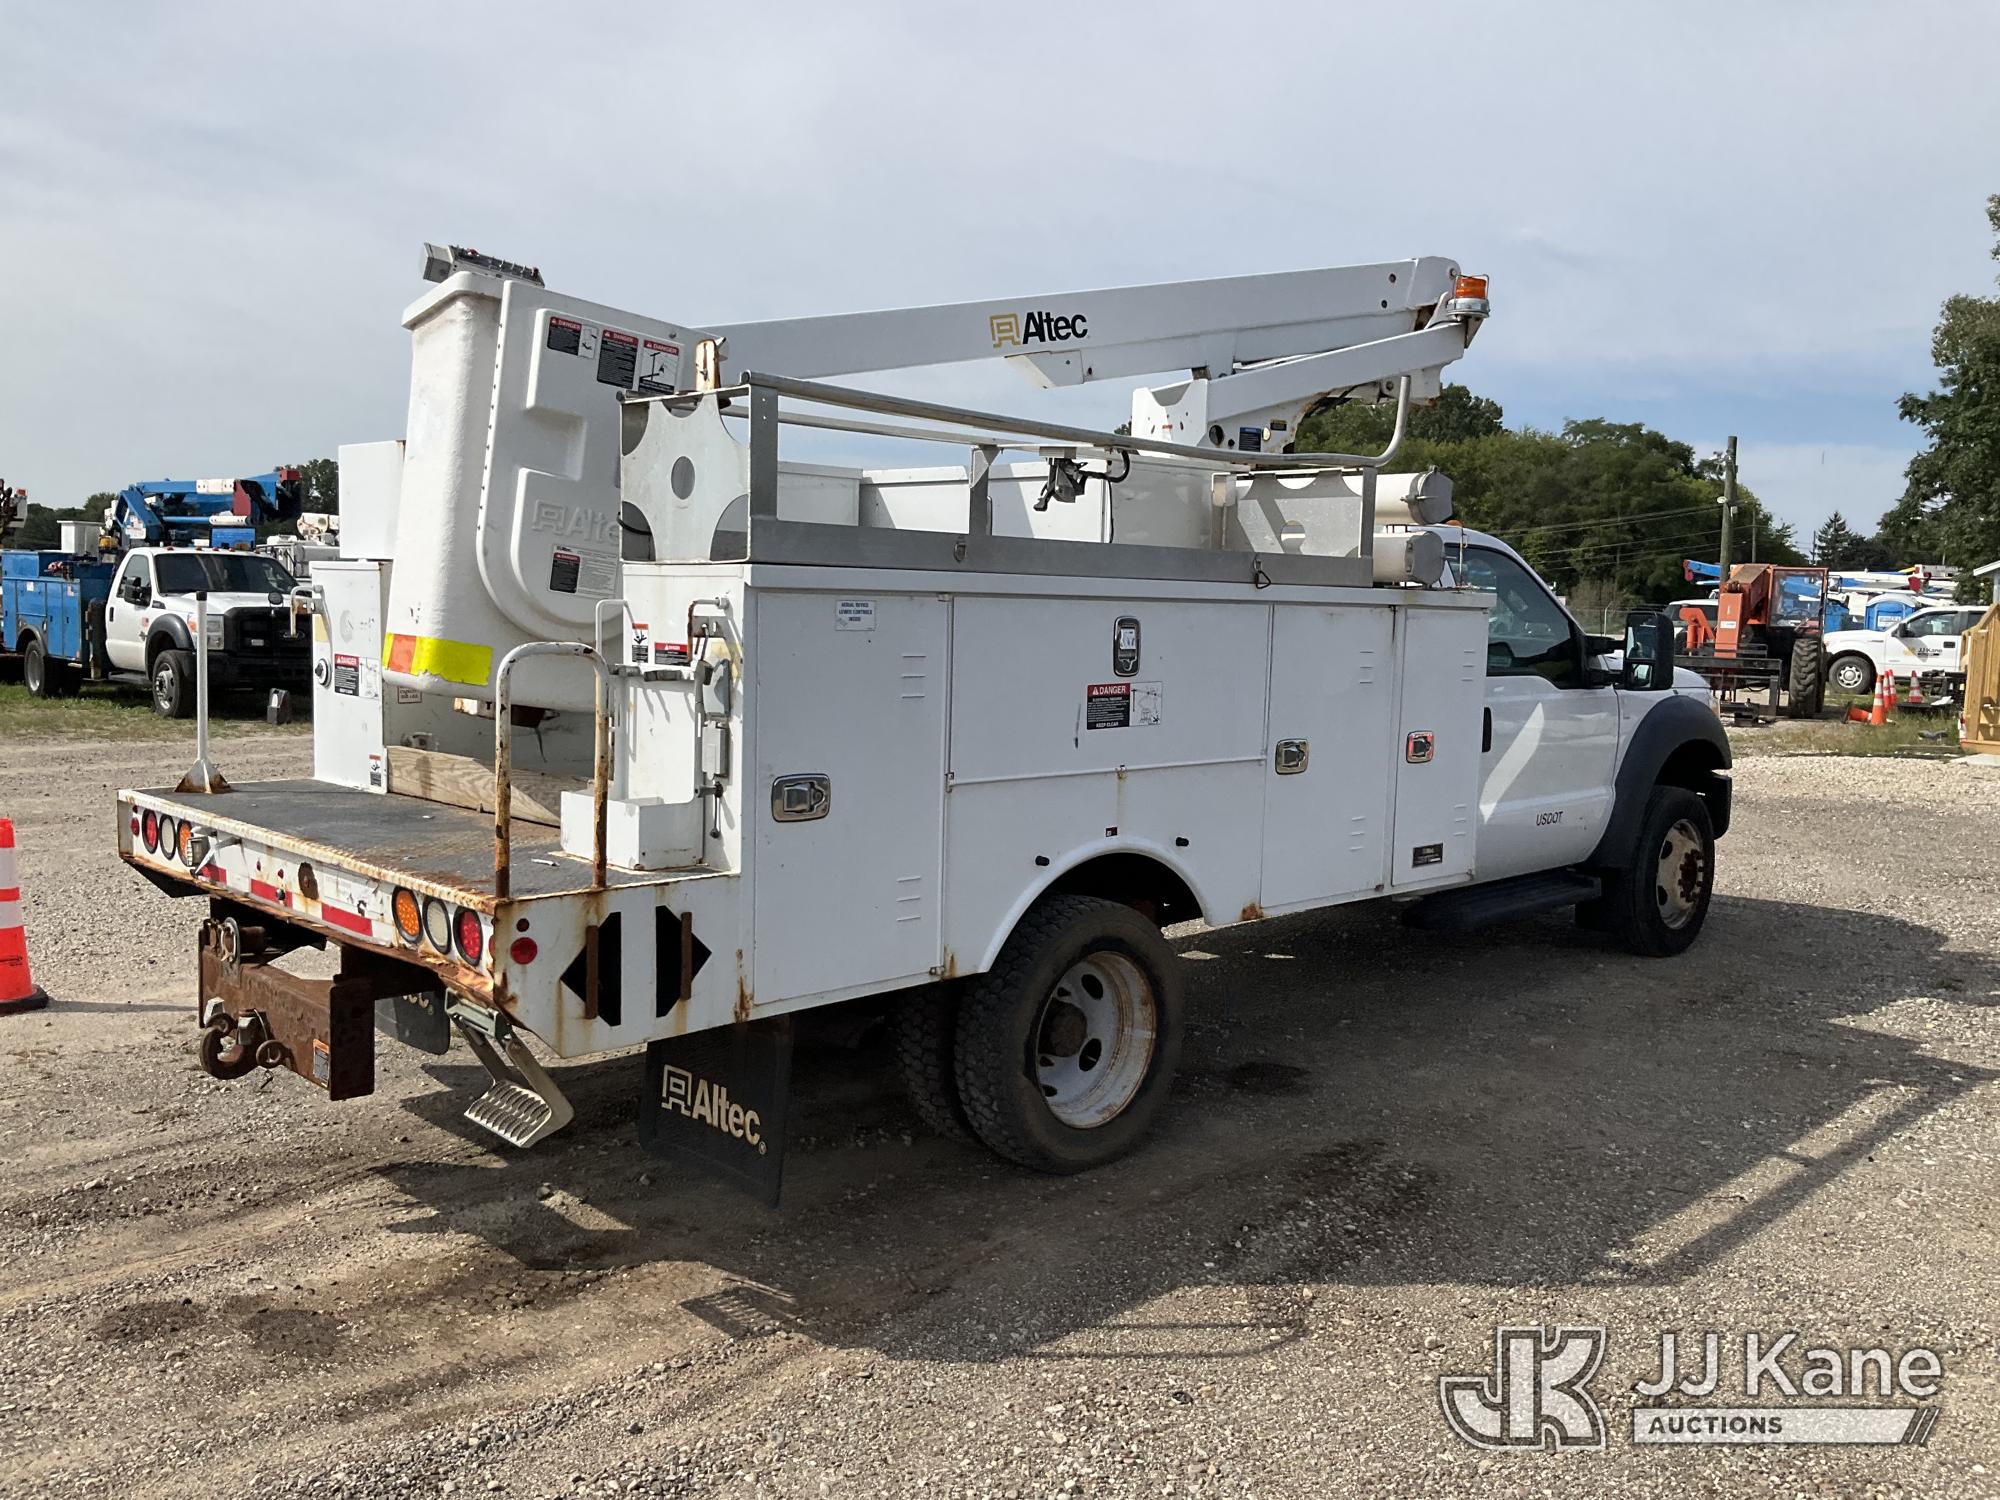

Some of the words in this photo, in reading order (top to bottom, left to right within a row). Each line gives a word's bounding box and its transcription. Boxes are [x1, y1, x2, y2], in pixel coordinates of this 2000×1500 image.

[558, 319, 581, 331] DANGER
[1022, 311, 1088, 344] Altec
[613, 332, 634, 344] DANGER
[653, 343, 678, 354] DANGER
[565, 506, 619, 547] Alte
[1100, 685, 1126, 695] DANGER
[1536, 811, 1563, 826] USDOT
[692, 1079, 760, 1145] Altec
